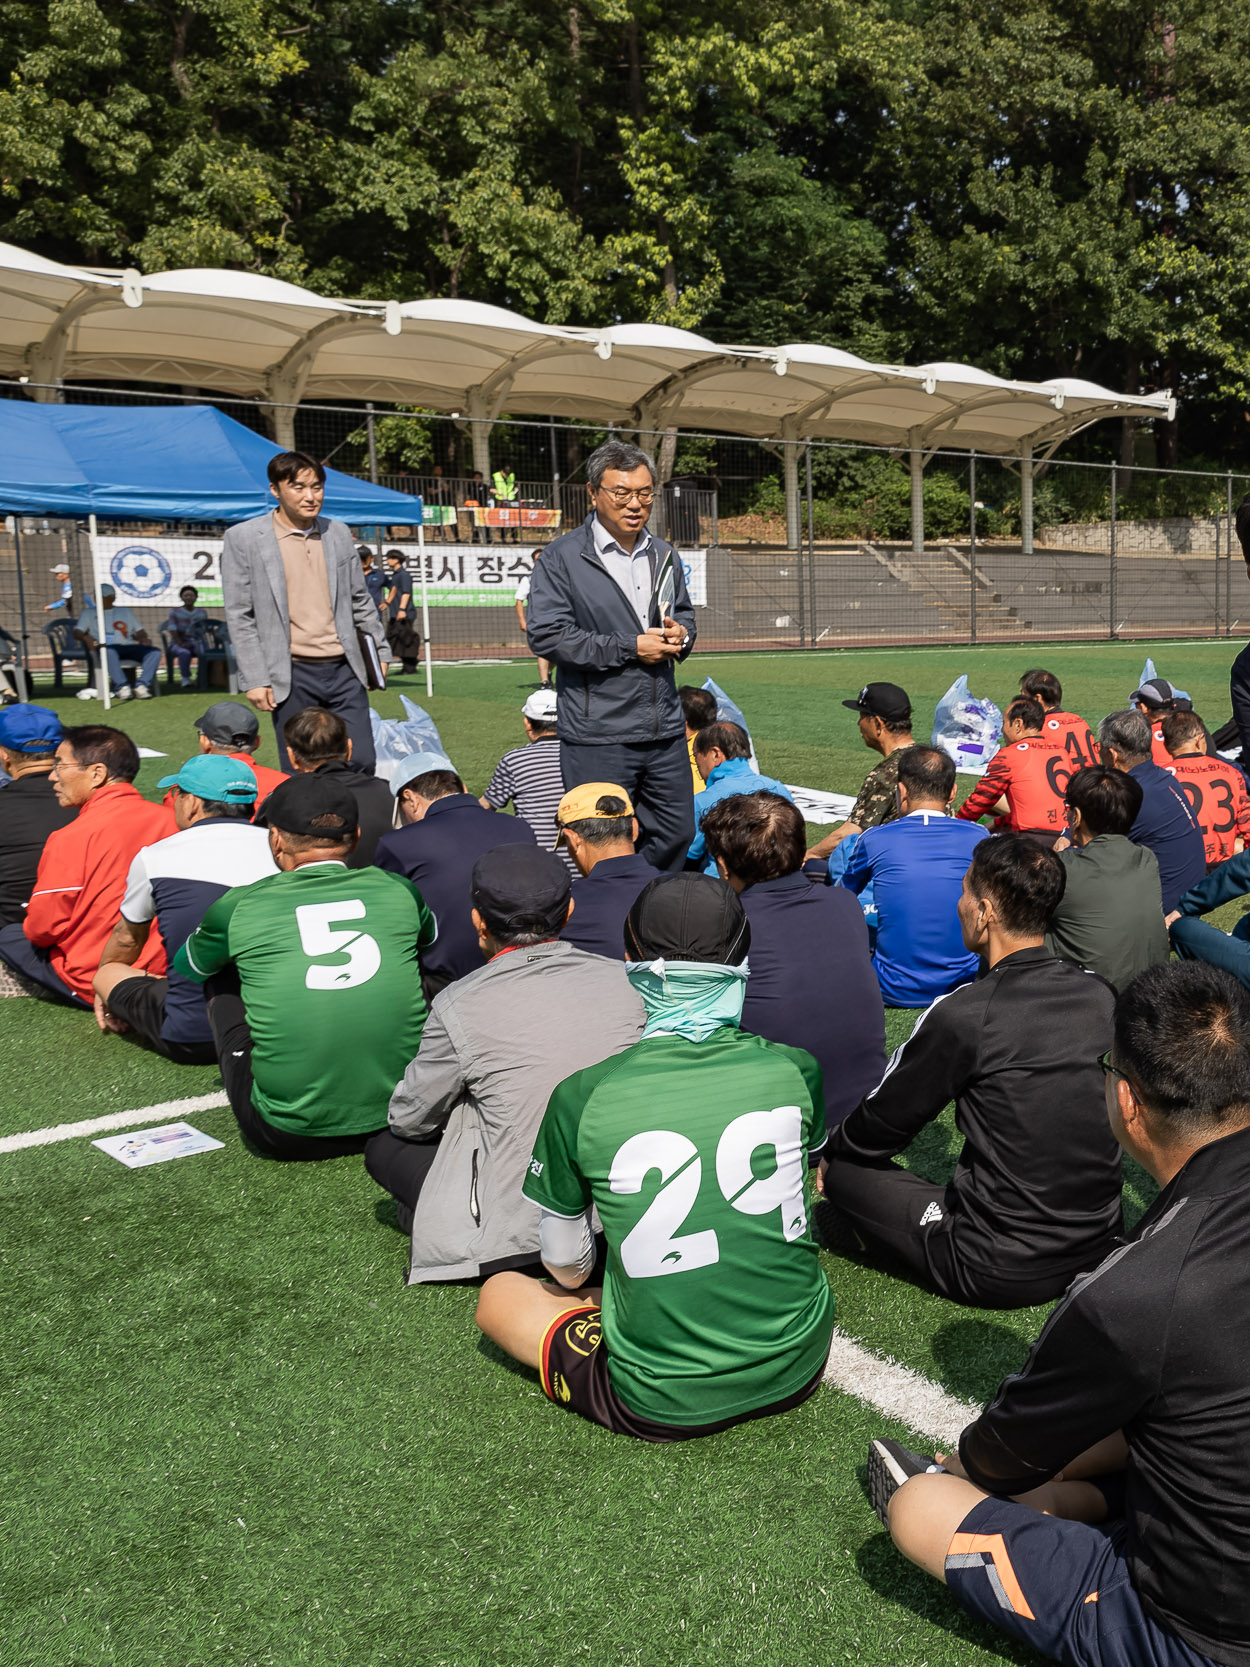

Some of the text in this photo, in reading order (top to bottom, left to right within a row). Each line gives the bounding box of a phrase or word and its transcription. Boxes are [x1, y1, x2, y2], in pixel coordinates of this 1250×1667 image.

[1046, 756, 1071, 799] 6
[295, 899, 381, 990] 5
[528, 1155, 544, 1177] 진
[608, 1105, 807, 1278] 29
